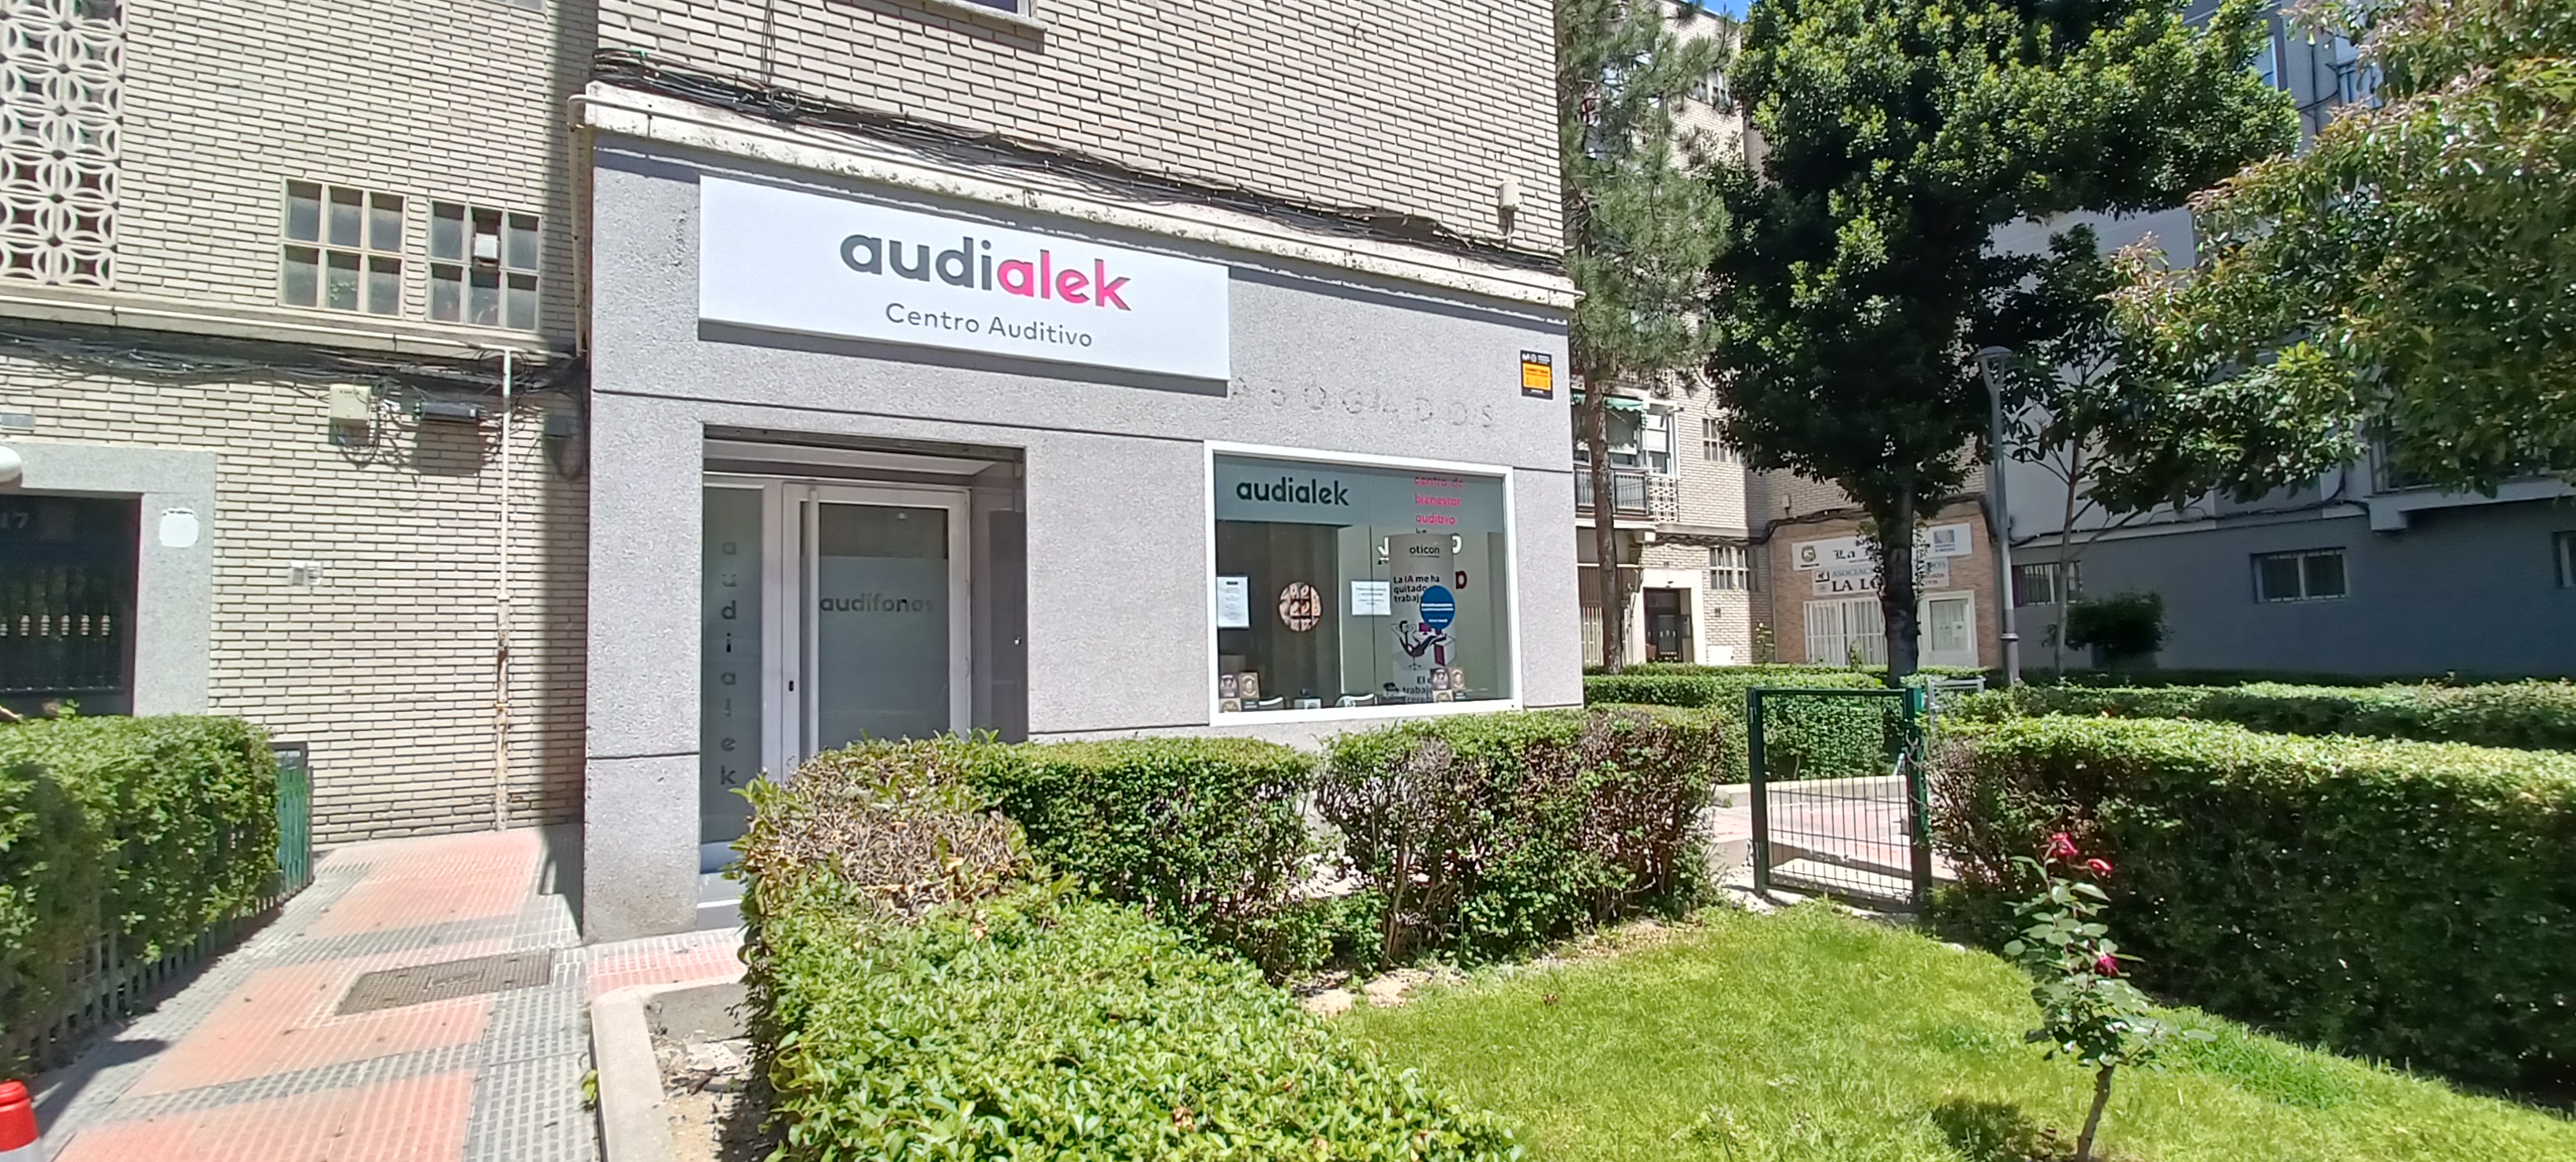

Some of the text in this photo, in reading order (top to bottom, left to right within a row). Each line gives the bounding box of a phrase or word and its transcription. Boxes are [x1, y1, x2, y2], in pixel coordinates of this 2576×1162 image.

[840, 234, 1132, 311] audialek
[886, 302, 1092, 347] Centro Auditivo
[1236, 476, 1350, 506] audialek
[1415, 493, 1461, 506] bienestar
[1416, 513, 1456, 525] auditivo
[1409, 545, 1440, 555] oticon
[1394, 584, 1427, 594] quitado
[1832, 580, 1853, 592] LA
[1394, 594, 1421, 603] trabaj
[720, 541, 737, 786] audialek
